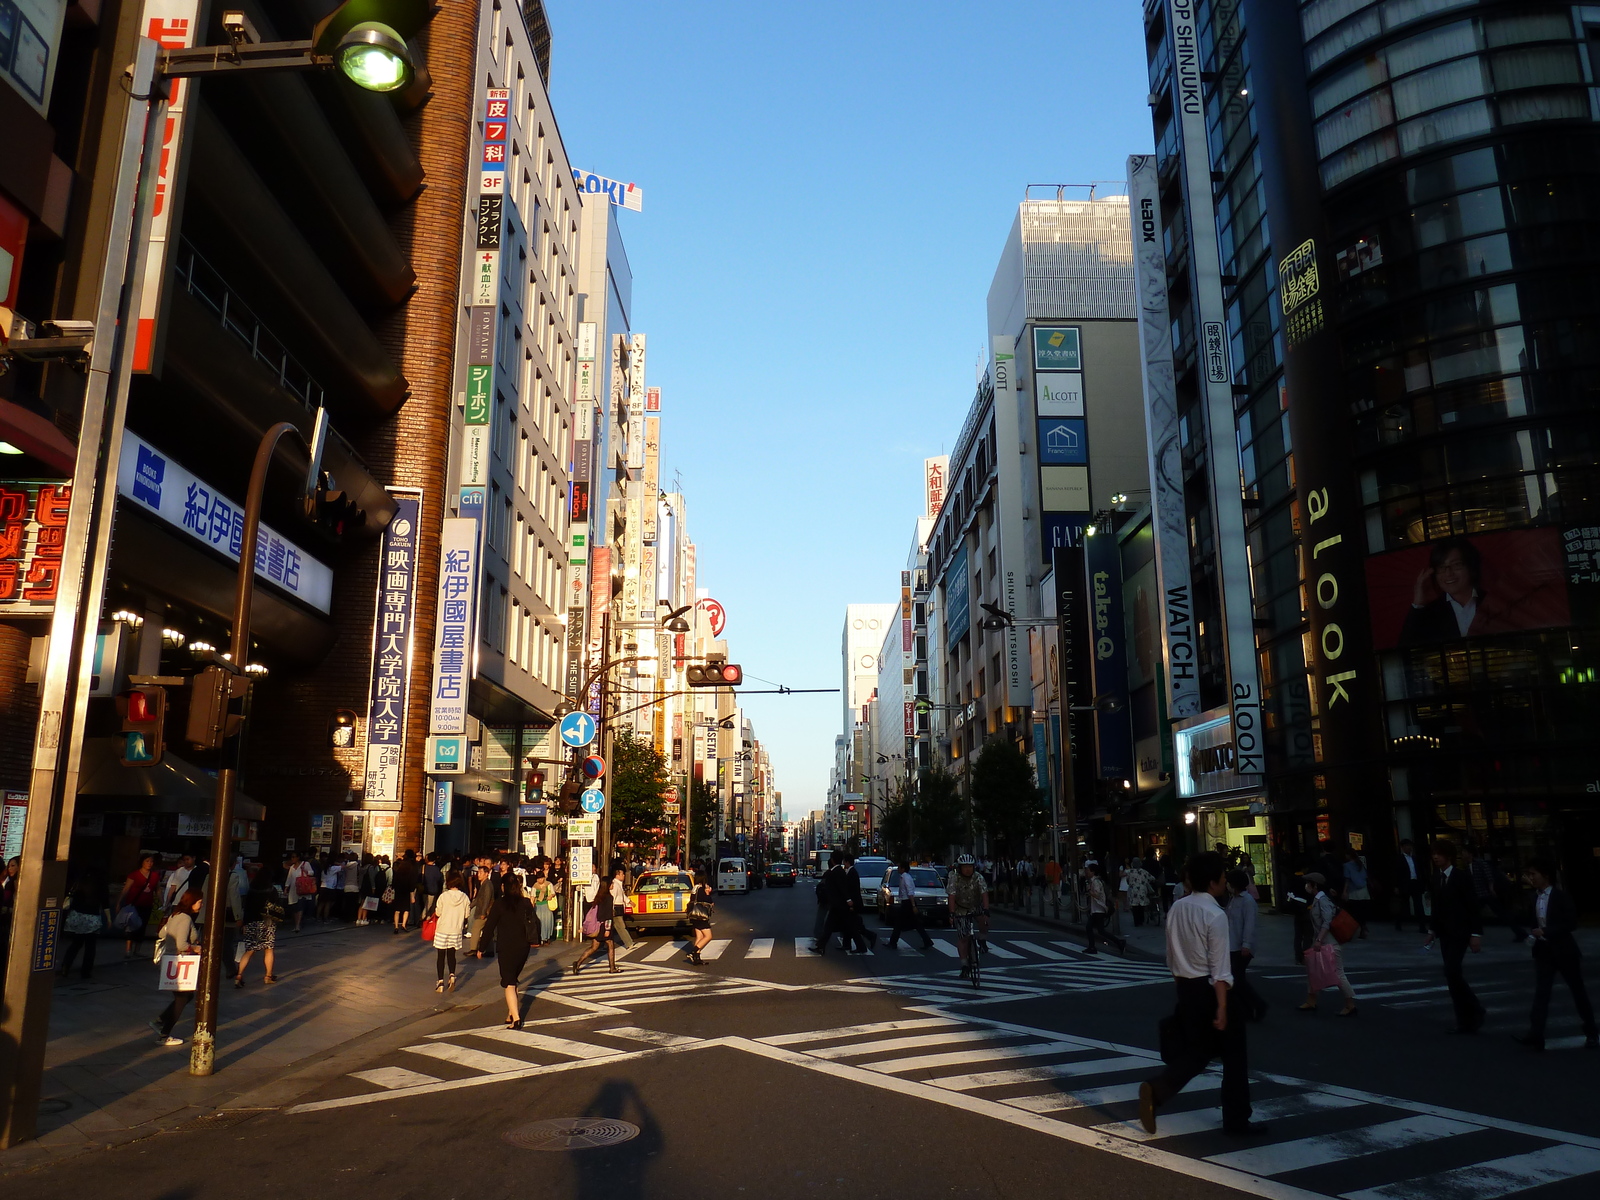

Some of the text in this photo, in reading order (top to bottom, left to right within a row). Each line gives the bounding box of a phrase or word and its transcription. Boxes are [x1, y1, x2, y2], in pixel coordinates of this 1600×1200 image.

[1177, 25, 1200, 114] SHINJUKU
[489, 90, 507, 98] 新宿
[485, 101, 507, 162] 皮フ科
[483, 178, 502, 188] 3F
[479, 199, 490, 244] コンタクト
[489, 198, 502, 244] プライス
[480, 263, 492, 297] 献血ルーム
[480, 311, 490, 359] FONTAINE
[1207, 325, 1224, 380] 眼鏡市場
[995, 352, 1014, 391] ALCOTT
[1043, 385, 1078, 401] ALCOTT
[136, 472, 160, 494] KINOKUNIYA
[142, 464, 157, 479] BOOKS
[461, 491, 482, 504] citi
[572, 486, 580, 518] union
[929, 463, 942, 516] 大和証券
[183, 481, 302, 591] 紀伊國屋書店
[1053, 526, 1083, 548] GAP
[1307, 487, 1357, 710] alook
[436, 549, 470, 699] 紀伊國屋書店
[1167, 585, 1194, 689] WATCH.
[373, 549, 410, 741] 映画専門大学院大学
[1010, 626, 1018, 688] MITSUKOSHI
[570, 658, 578, 675] THE
[568, 676, 576, 694] SUIT
[434, 706, 462, 714] 営業時間
[1234, 683, 1263, 771] alook
[376, 746, 391, 798] プロデュース
[388, 746, 399, 766] 映画
[1199, 742, 1234, 774] WATC
[366, 771, 378, 798] 研究科
[438, 787, 447, 818] citibank
[586, 794, 596, 810] P
[166, 960, 194, 980] UT
